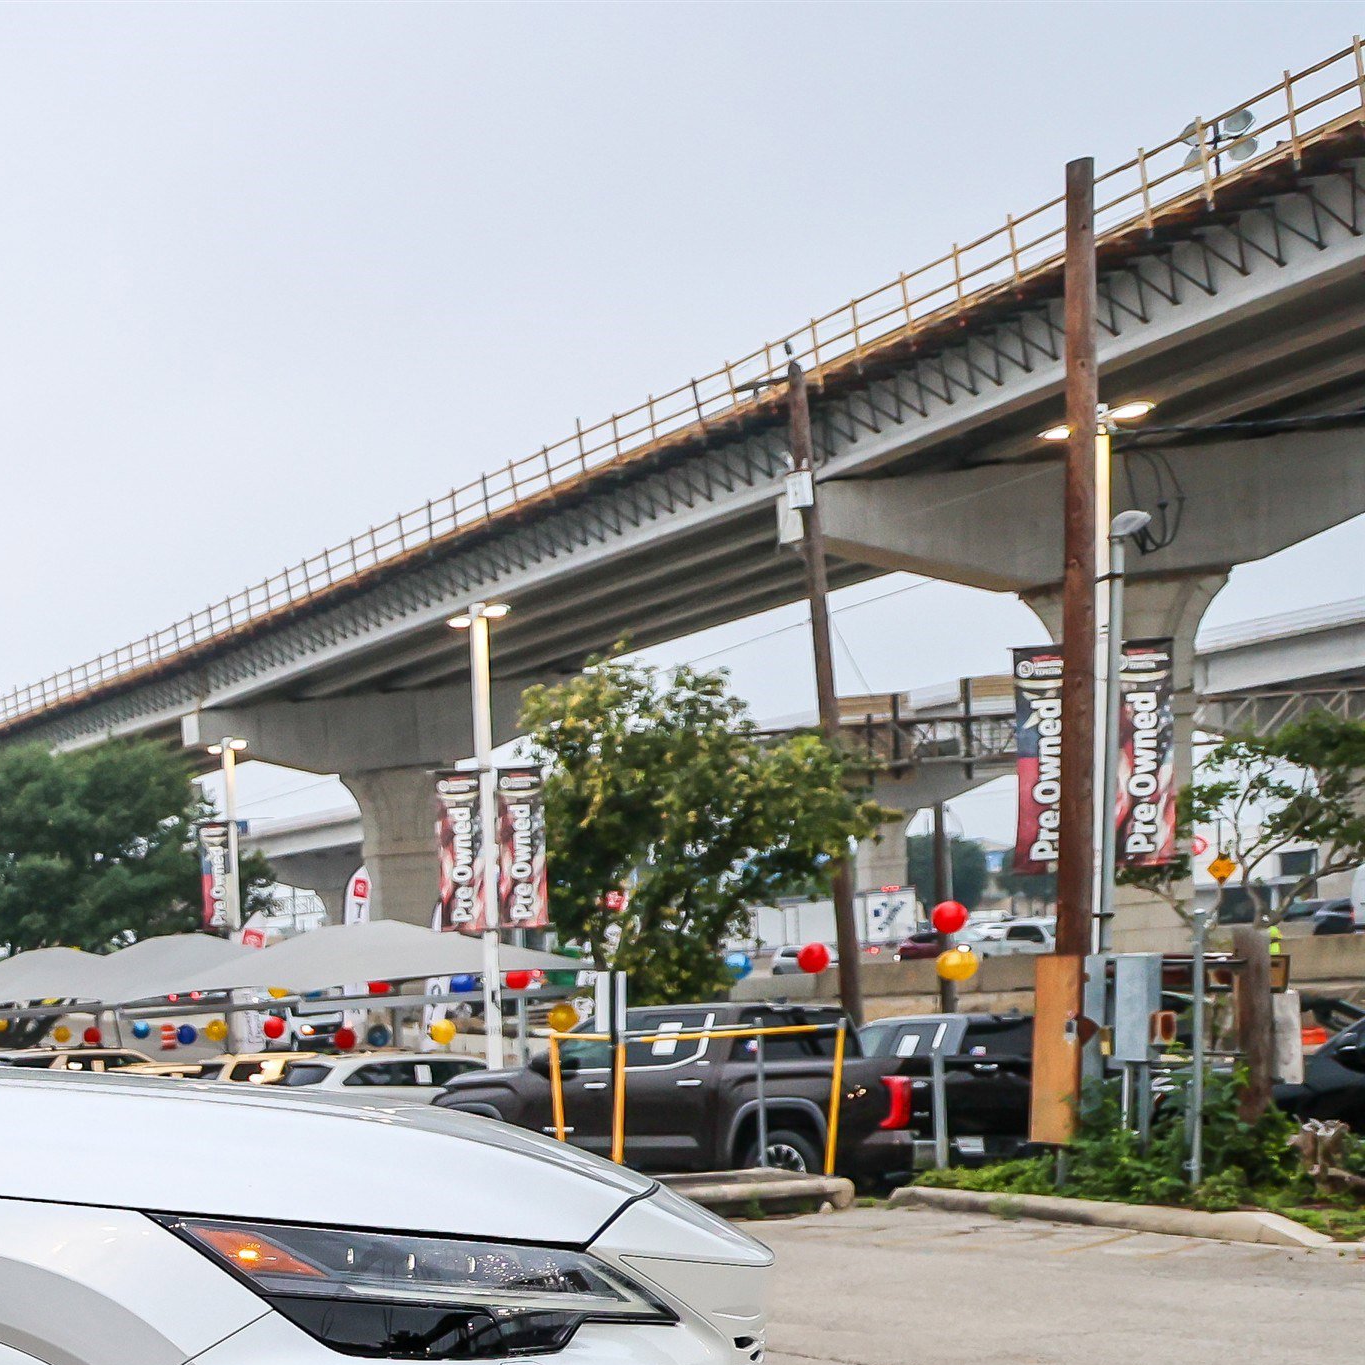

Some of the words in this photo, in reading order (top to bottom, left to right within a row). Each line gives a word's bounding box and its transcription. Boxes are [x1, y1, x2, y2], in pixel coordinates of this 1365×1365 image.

[1030, 699, 1062, 804] Owned
[1125, 692, 1158, 797] Owned
[447, 807, 473, 882] Owned
[508, 804, 532, 879] Owned
[1126, 803, 1156, 853] Pre
[451, 886, 473, 922] Pre
[510, 882, 533, 919] Pre
